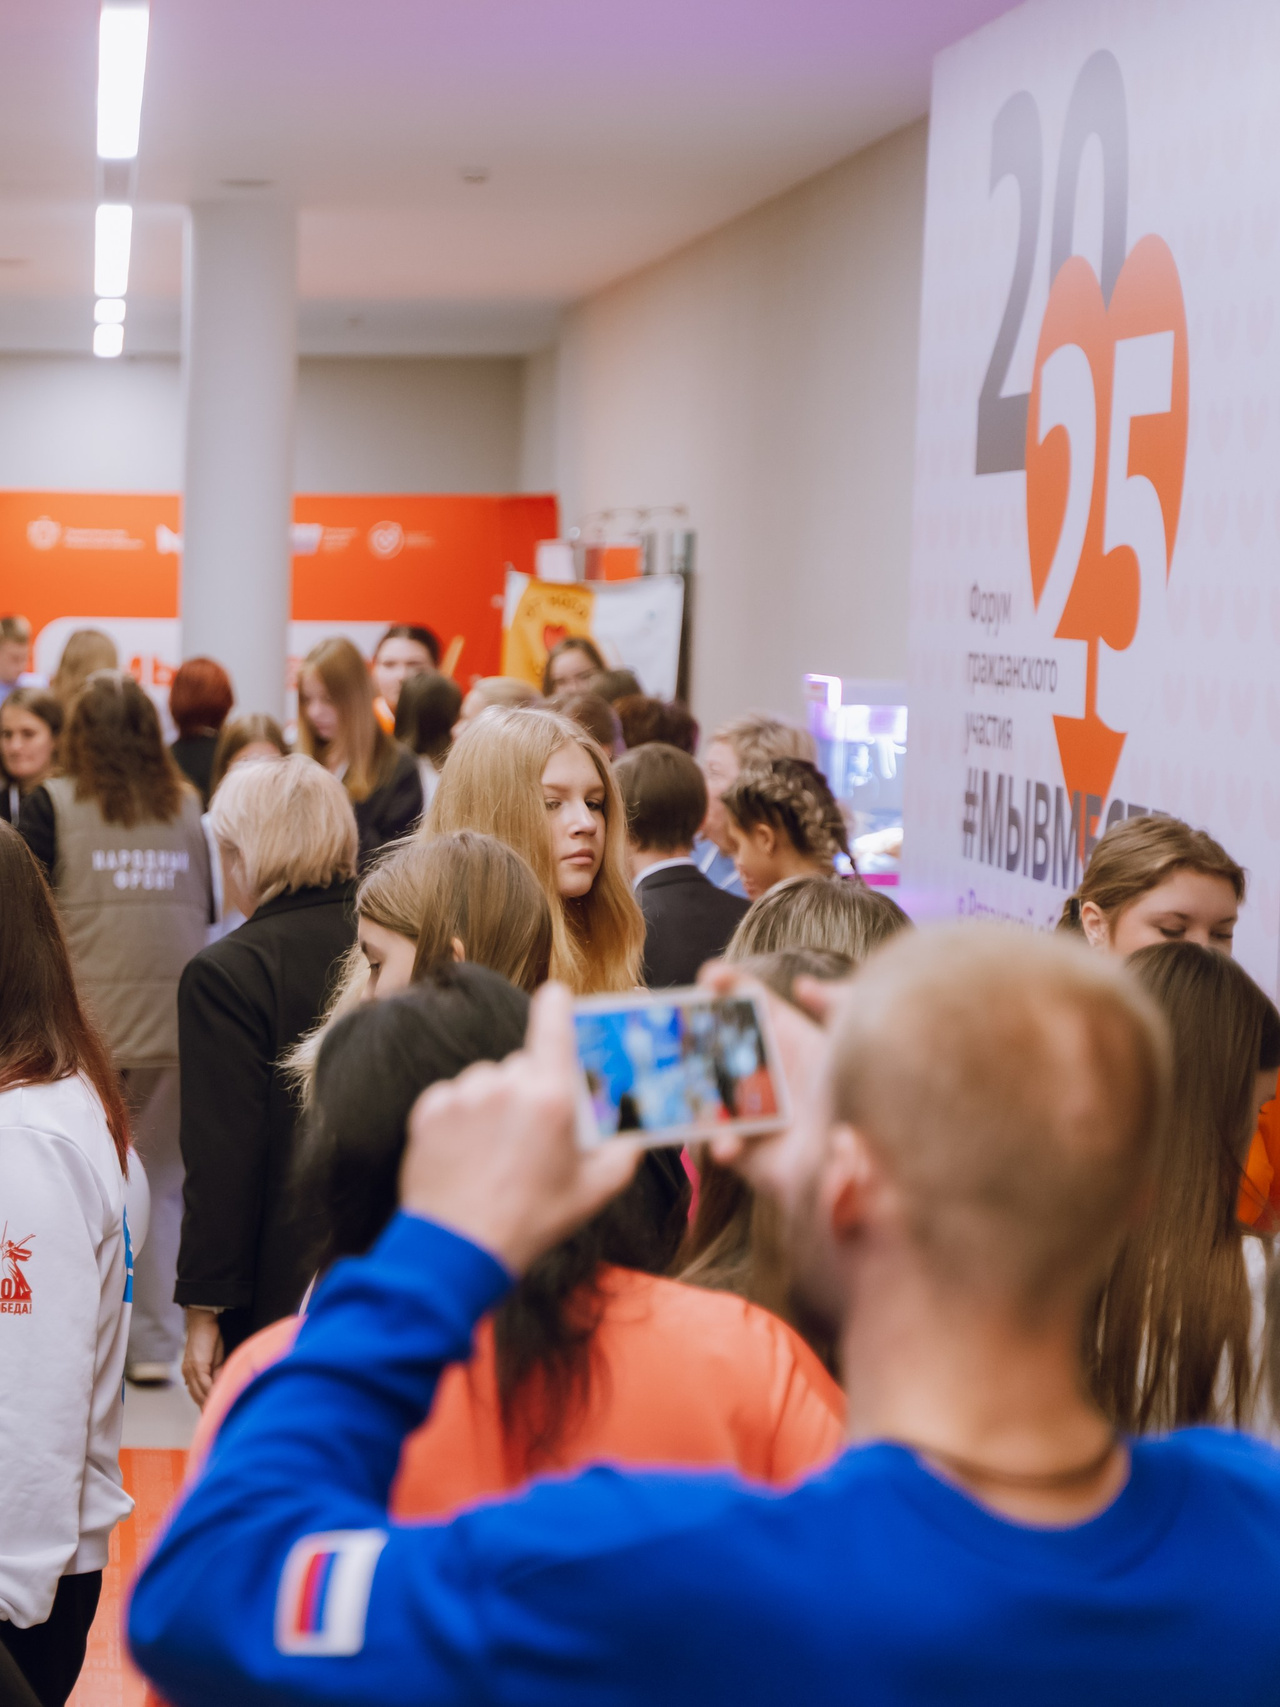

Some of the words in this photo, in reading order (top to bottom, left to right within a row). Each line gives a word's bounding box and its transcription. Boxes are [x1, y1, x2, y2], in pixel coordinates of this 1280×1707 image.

[1028, 326, 1174, 734] 25
[968, 578, 1011, 637] Форум
[967, 651, 1058, 695] гражданского
[963, 711, 1013, 755] участия
